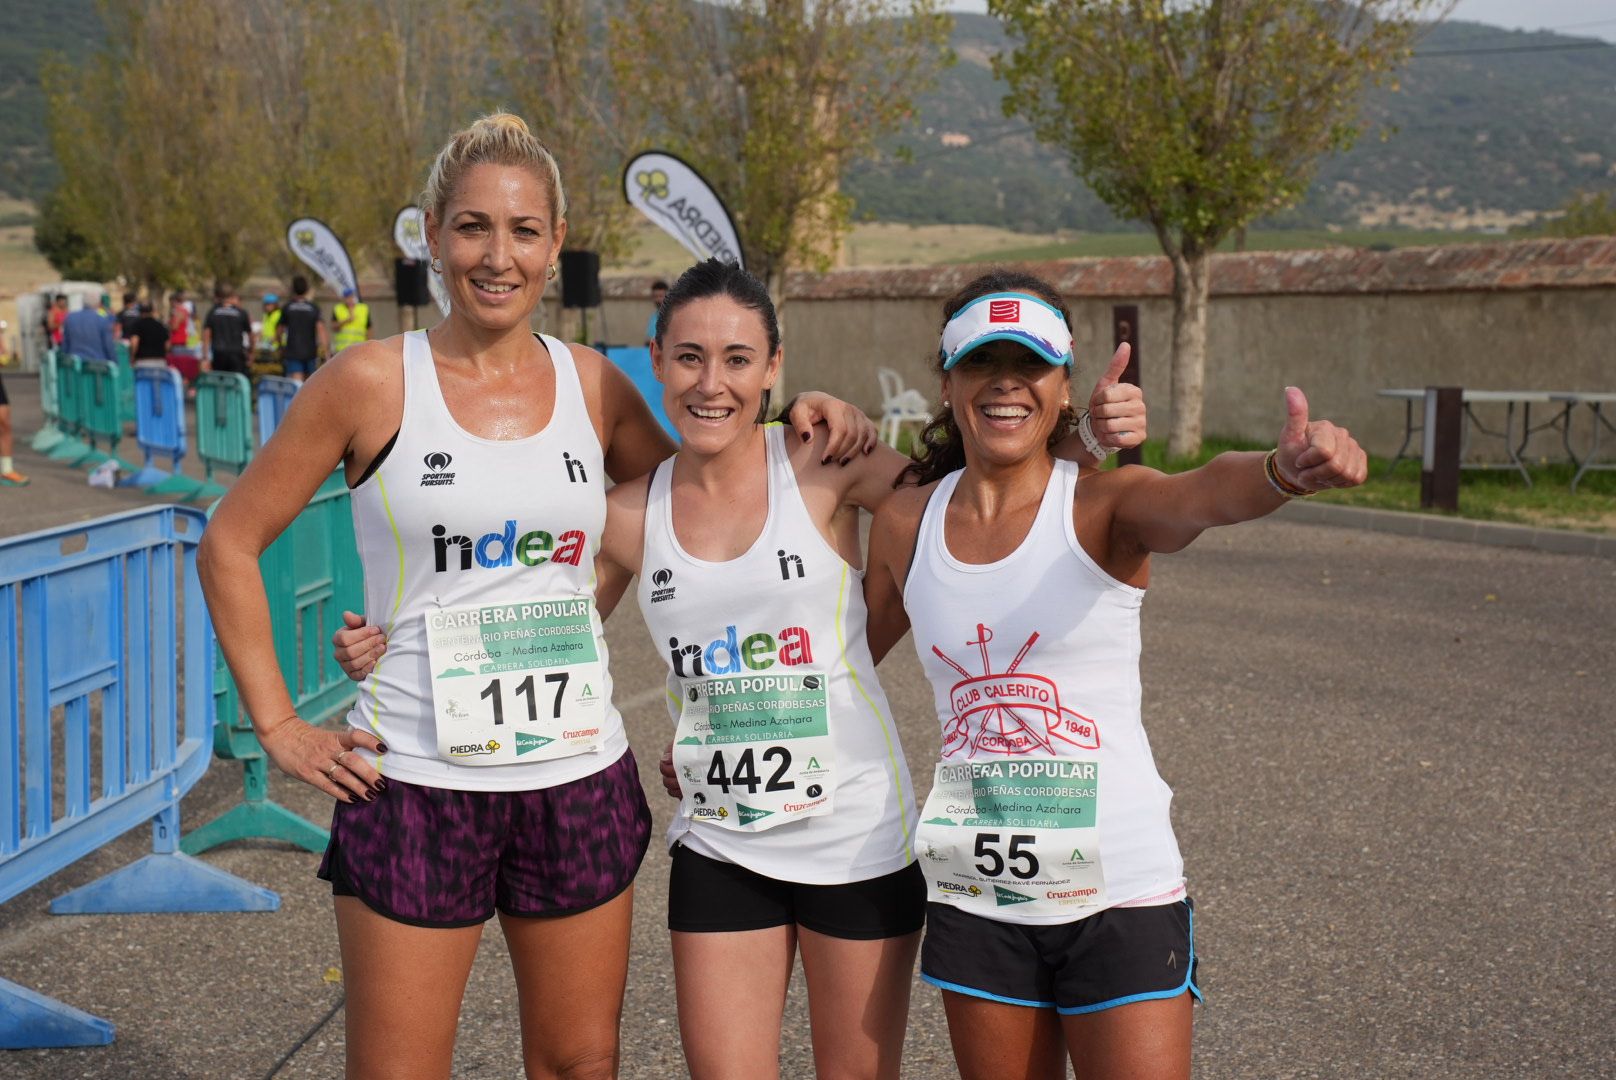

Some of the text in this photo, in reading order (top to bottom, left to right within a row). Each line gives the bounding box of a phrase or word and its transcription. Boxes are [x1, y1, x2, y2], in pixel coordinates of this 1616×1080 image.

[422, 473, 455, 481] SPORTING
[432, 520, 586, 572] indea
[651, 587, 676, 597] SPORTING
[431, 601, 587, 630] CARRERA POPULAR
[503, 627, 537, 640] PEÑAS
[538, 623, 592, 638] CORDOBESAS
[454, 650, 502, 662] Córdoba
[512, 643, 548, 656] Medina
[550, 641, 584, 652] Azahara
[669, 625, 813, 678] indea
[483, 657, 570, 673] CARRERA SOLIDARIA
[480, 672, 570, 725] 117
[722, 701, 755, 712] PEÑAS
[757, 698, 825, 711] CORDOBESAS
[956, 684, 1049, 712] CLUB CALERITO
[730, 717, 767, 729] Medina
[770, 715, 813, 726] Azahara
[1065, 720, 1091, 737] 1948
[563, 728, 599, 739] Cruzcampo
[707, 731, 794, 744] CARRERA SOLIDARIA
[707, 746, 795, 794] 442
[940, 762, 1095, 783] CARRERA POPULAR
[987, 784, 1021, 796] PEÑAS
[1023, 786, 1096, 798] CORDOBESAS
[946, 804, 987, 815] Córdoba
[993, 802, 1032, 813] Medina
[1035, 804, 1081, 815] Azahara
[966, 818, 1060, 828] CARRERA SOLIDARIA
[974, 833, 1040, 880] 55
[1047, 887, 1098, 900] Cruzcampo
